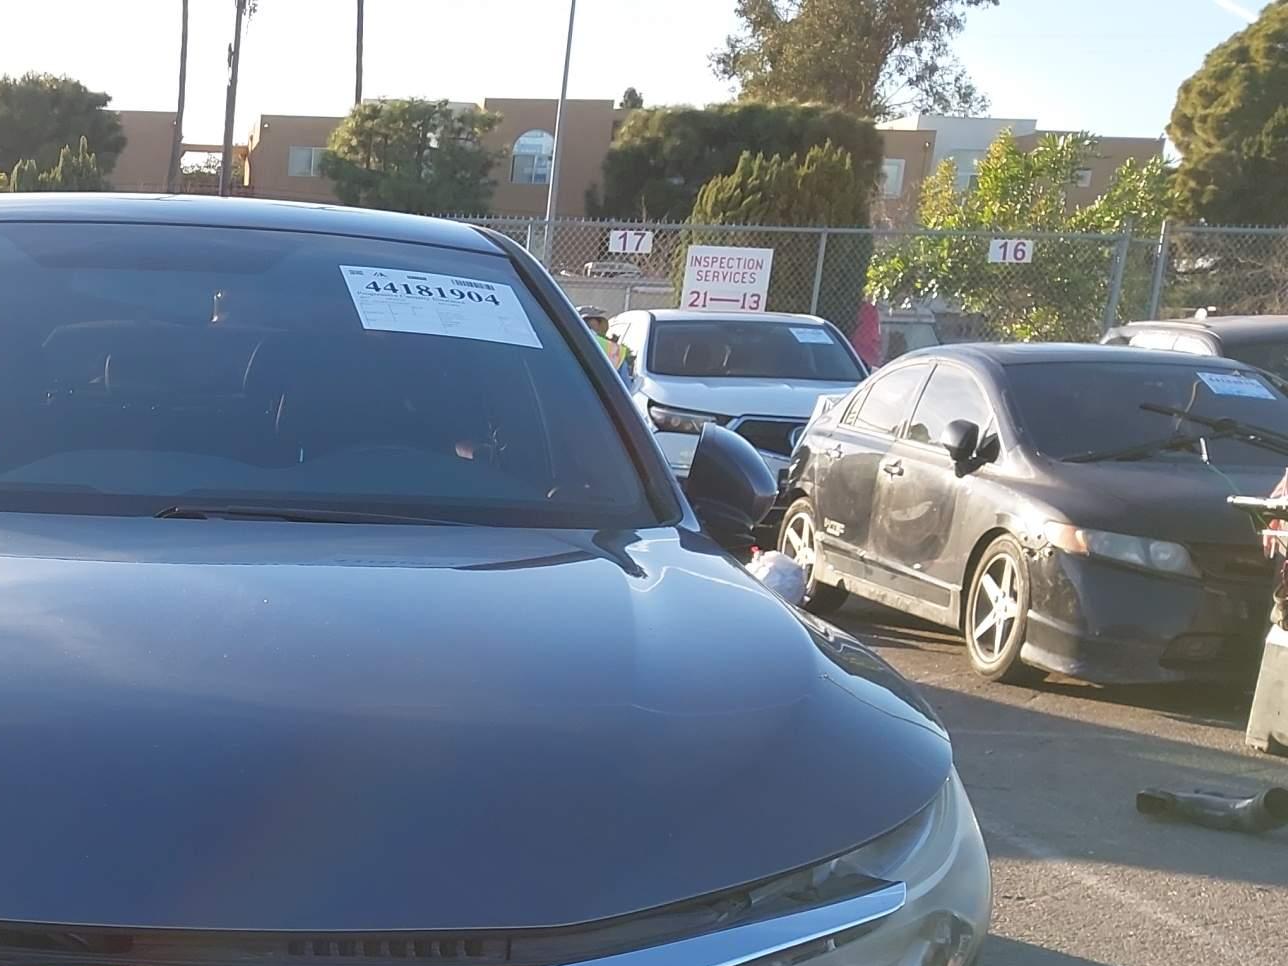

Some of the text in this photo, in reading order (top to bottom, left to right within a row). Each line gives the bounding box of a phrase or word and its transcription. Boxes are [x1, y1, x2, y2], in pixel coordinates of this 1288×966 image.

[618, 231, 647, 251] 17
[998, 241, 1027, 261] 16
[689, 255, 764, 271] INSPECTION
[695, 269, 757, 284] SERVICES
[365, 279, 501, 306] 44181904
